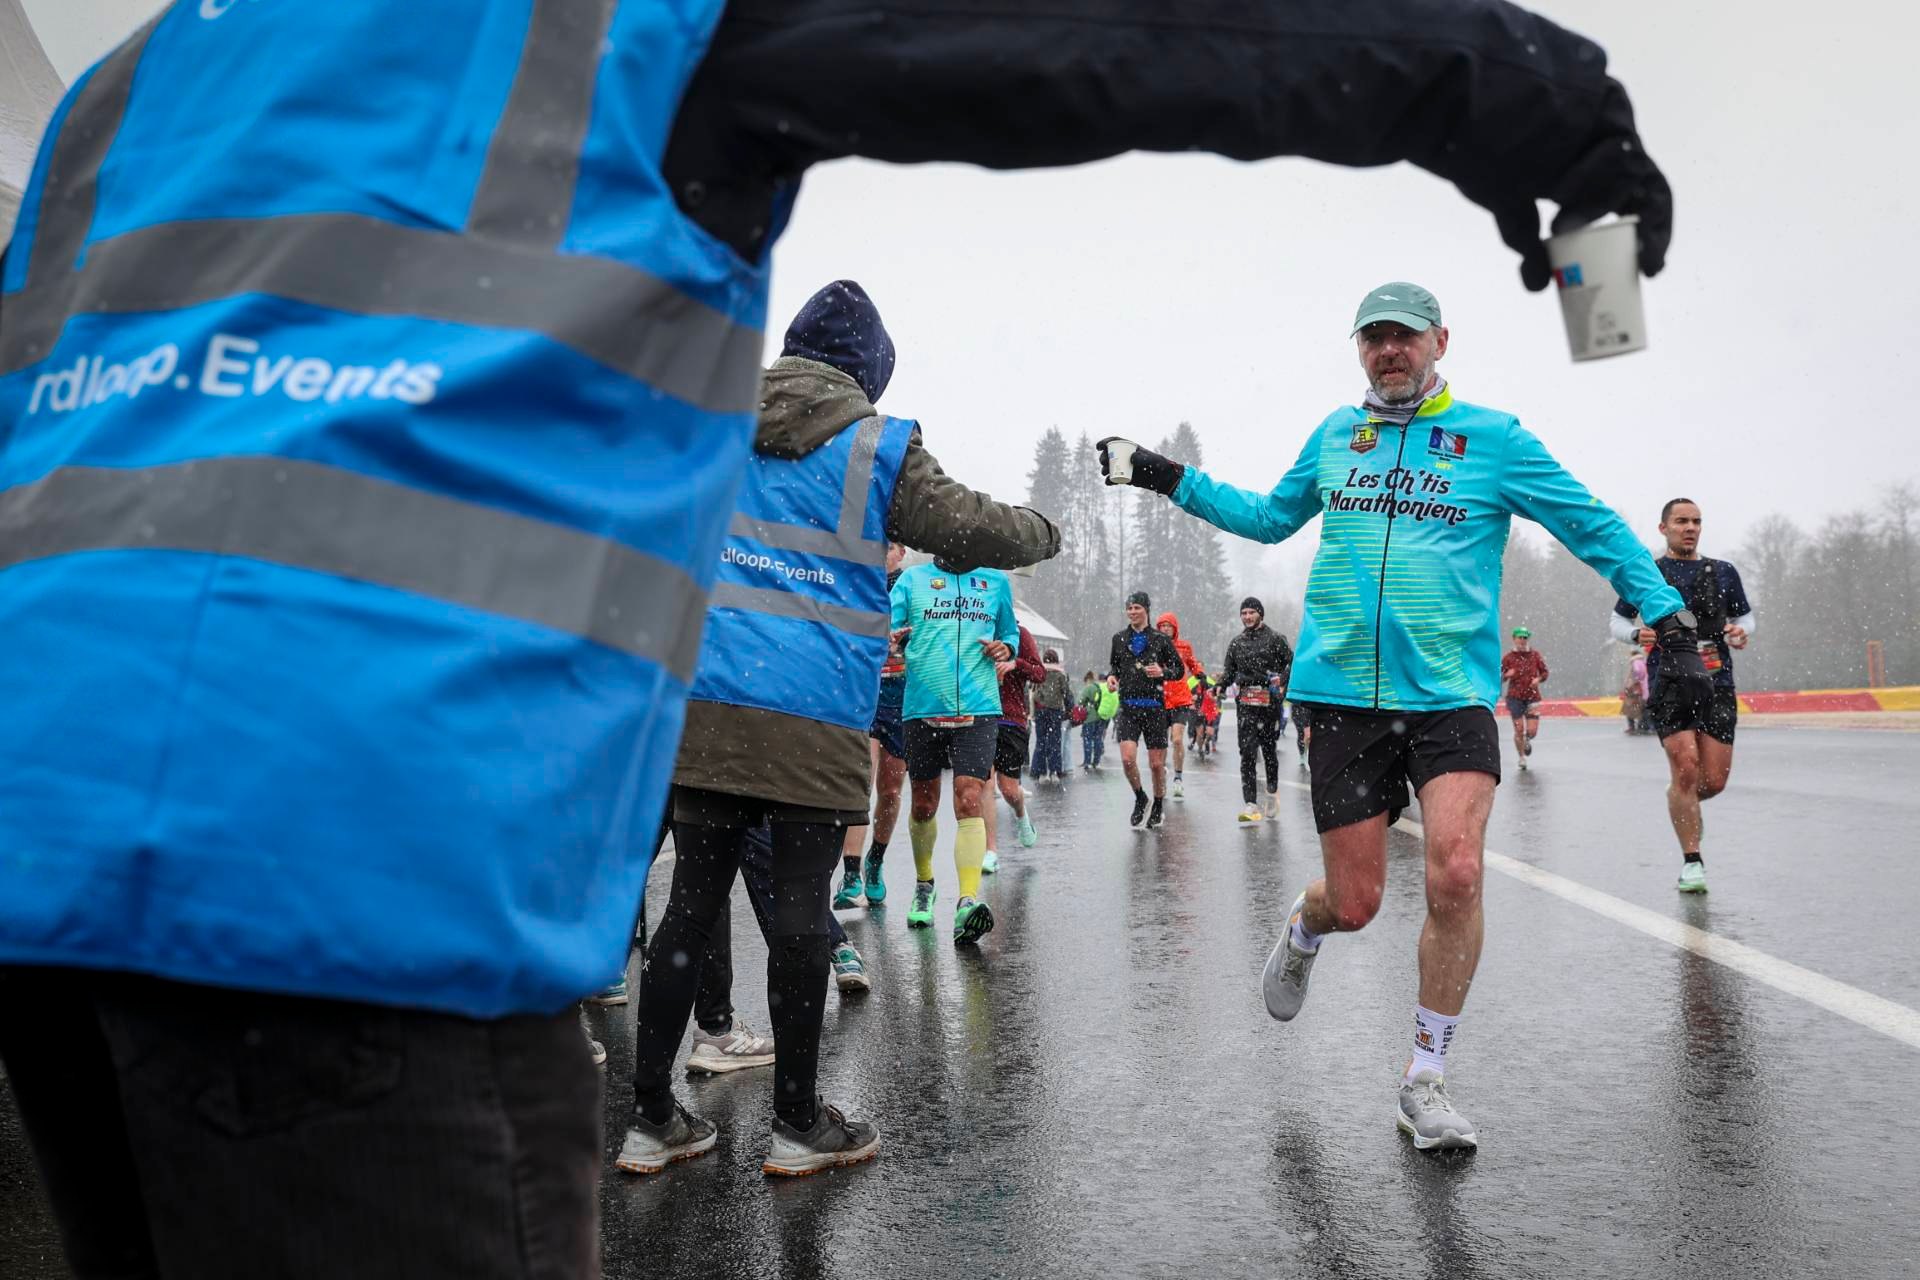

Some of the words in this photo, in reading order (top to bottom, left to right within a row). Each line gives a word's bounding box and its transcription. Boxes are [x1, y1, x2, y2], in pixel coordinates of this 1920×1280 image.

[28, 333, 442, 415] rdloop.Events
[1345, 467, 1381, 488] Les
[1328, 489, 1468, 526] Marathoniens
[720, 547, 836, 585] dloop.Events
[923, 608, 992, 624] Marathoniens
[933, 597, 952, 608] Les
